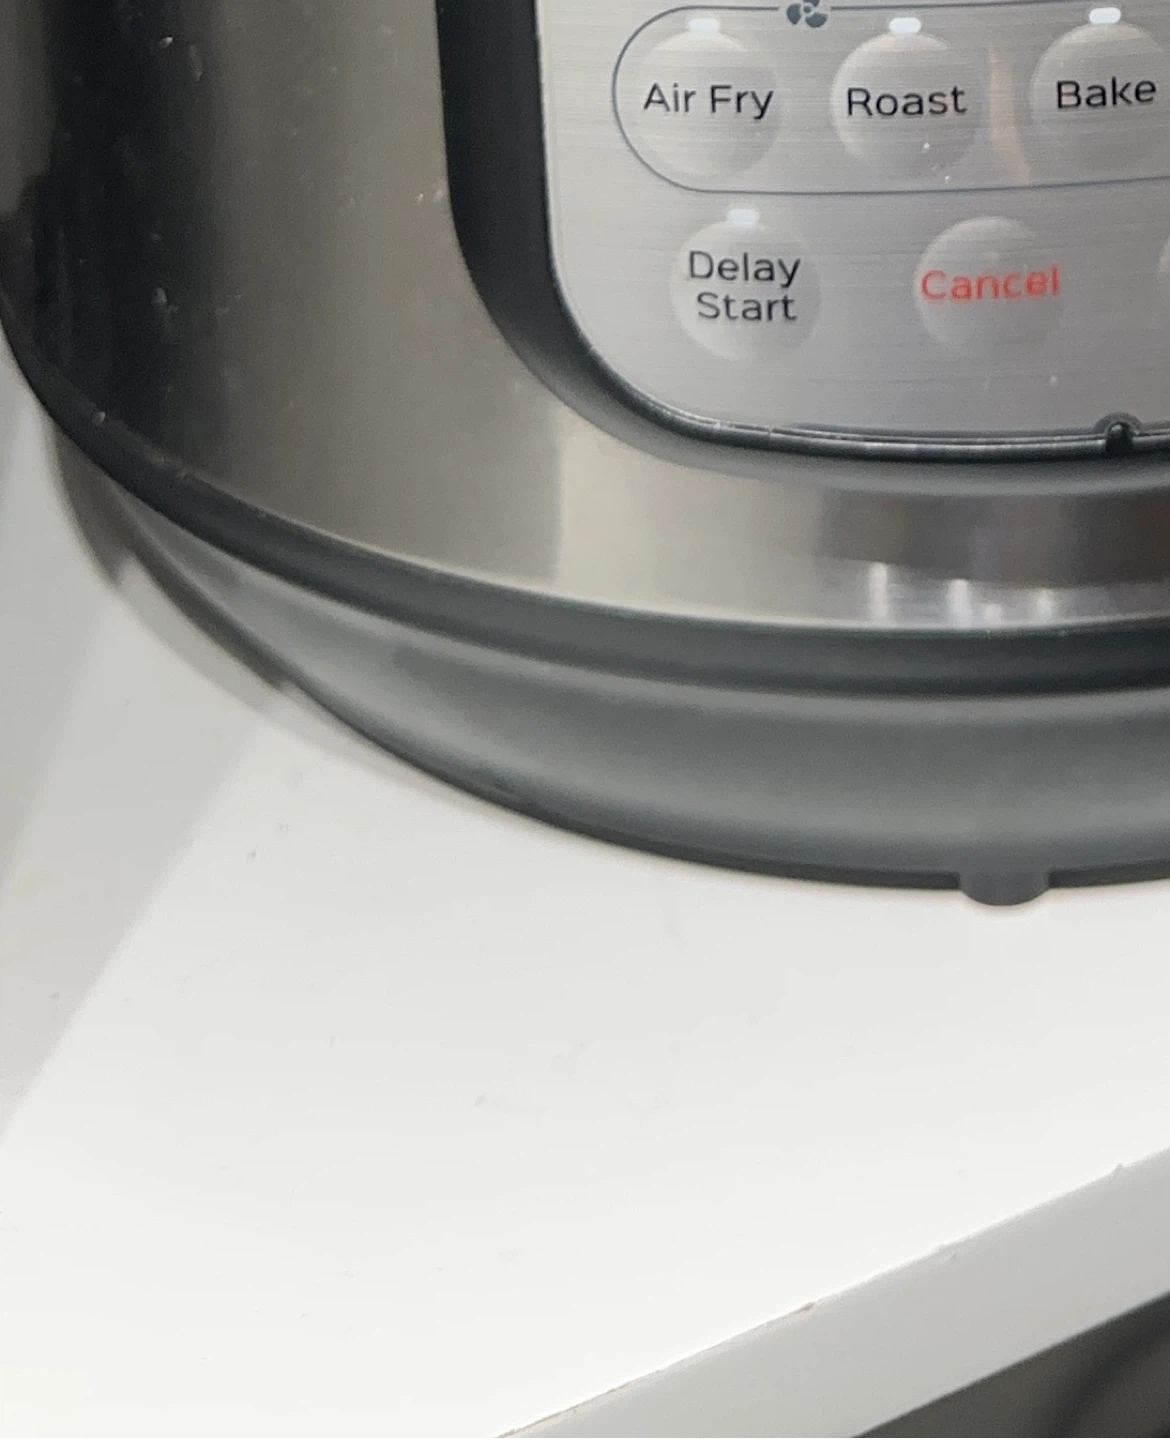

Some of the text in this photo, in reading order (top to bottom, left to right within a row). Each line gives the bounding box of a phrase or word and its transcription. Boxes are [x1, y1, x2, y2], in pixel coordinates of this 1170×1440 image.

[644, 83, 773, 120] Air Fry
[848, 87, 966, 116] Roast
[1057, 77, 1156, 109] Bake
[689, 251, 800, 289] Delay
[921, 264, 1060, 303] Cancel
[697, 291, 798, 321] Start
